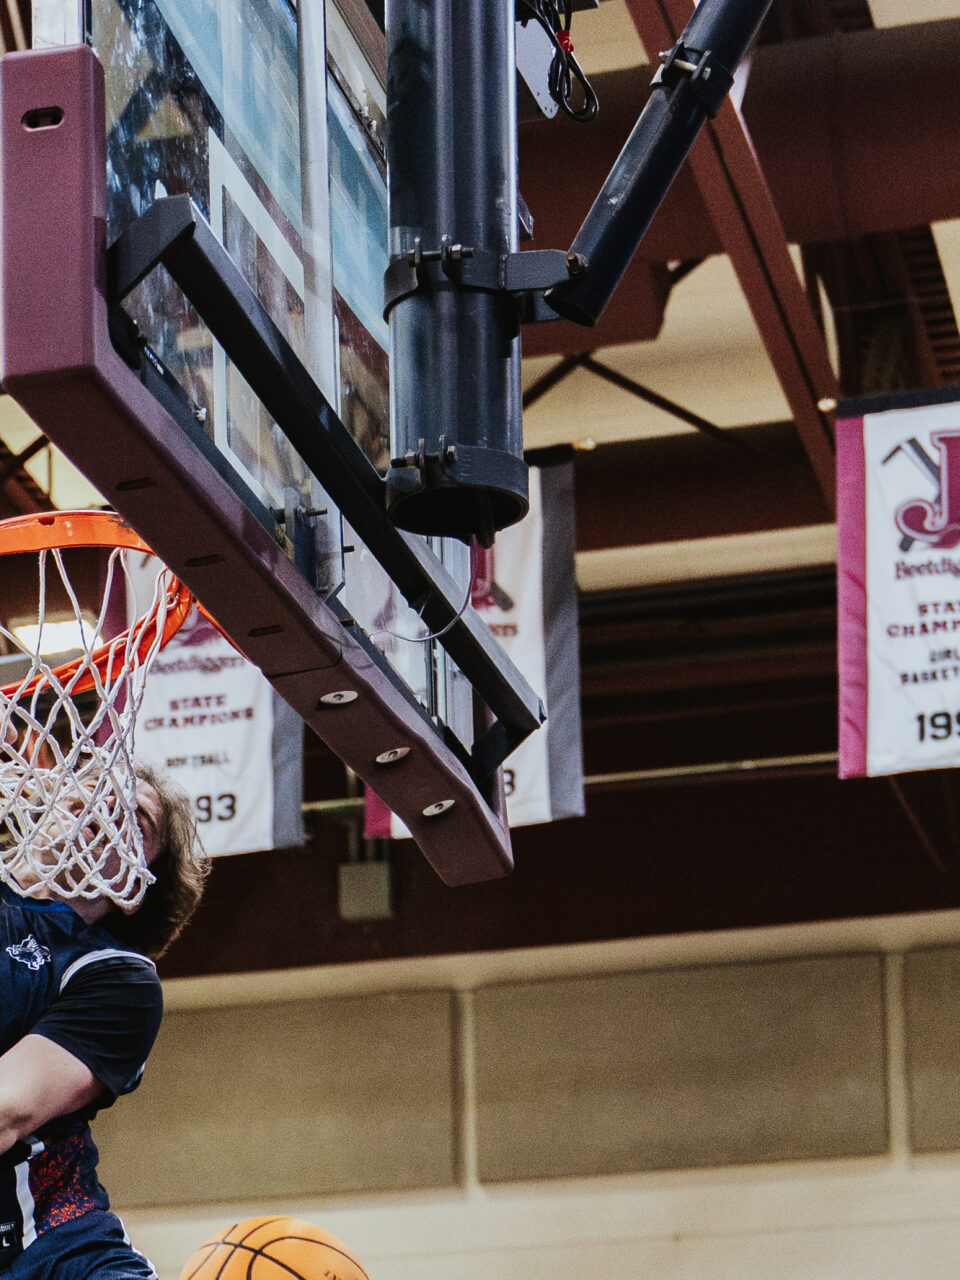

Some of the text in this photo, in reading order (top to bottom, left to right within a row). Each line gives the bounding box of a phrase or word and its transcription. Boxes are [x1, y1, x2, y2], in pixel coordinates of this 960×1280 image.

[918, 601, 960, 616] STA
[169, 694, 226, 711] STATE
[144, 707, 254, 731] CHAMPIONS
[916, 711, 960, 742] 19
